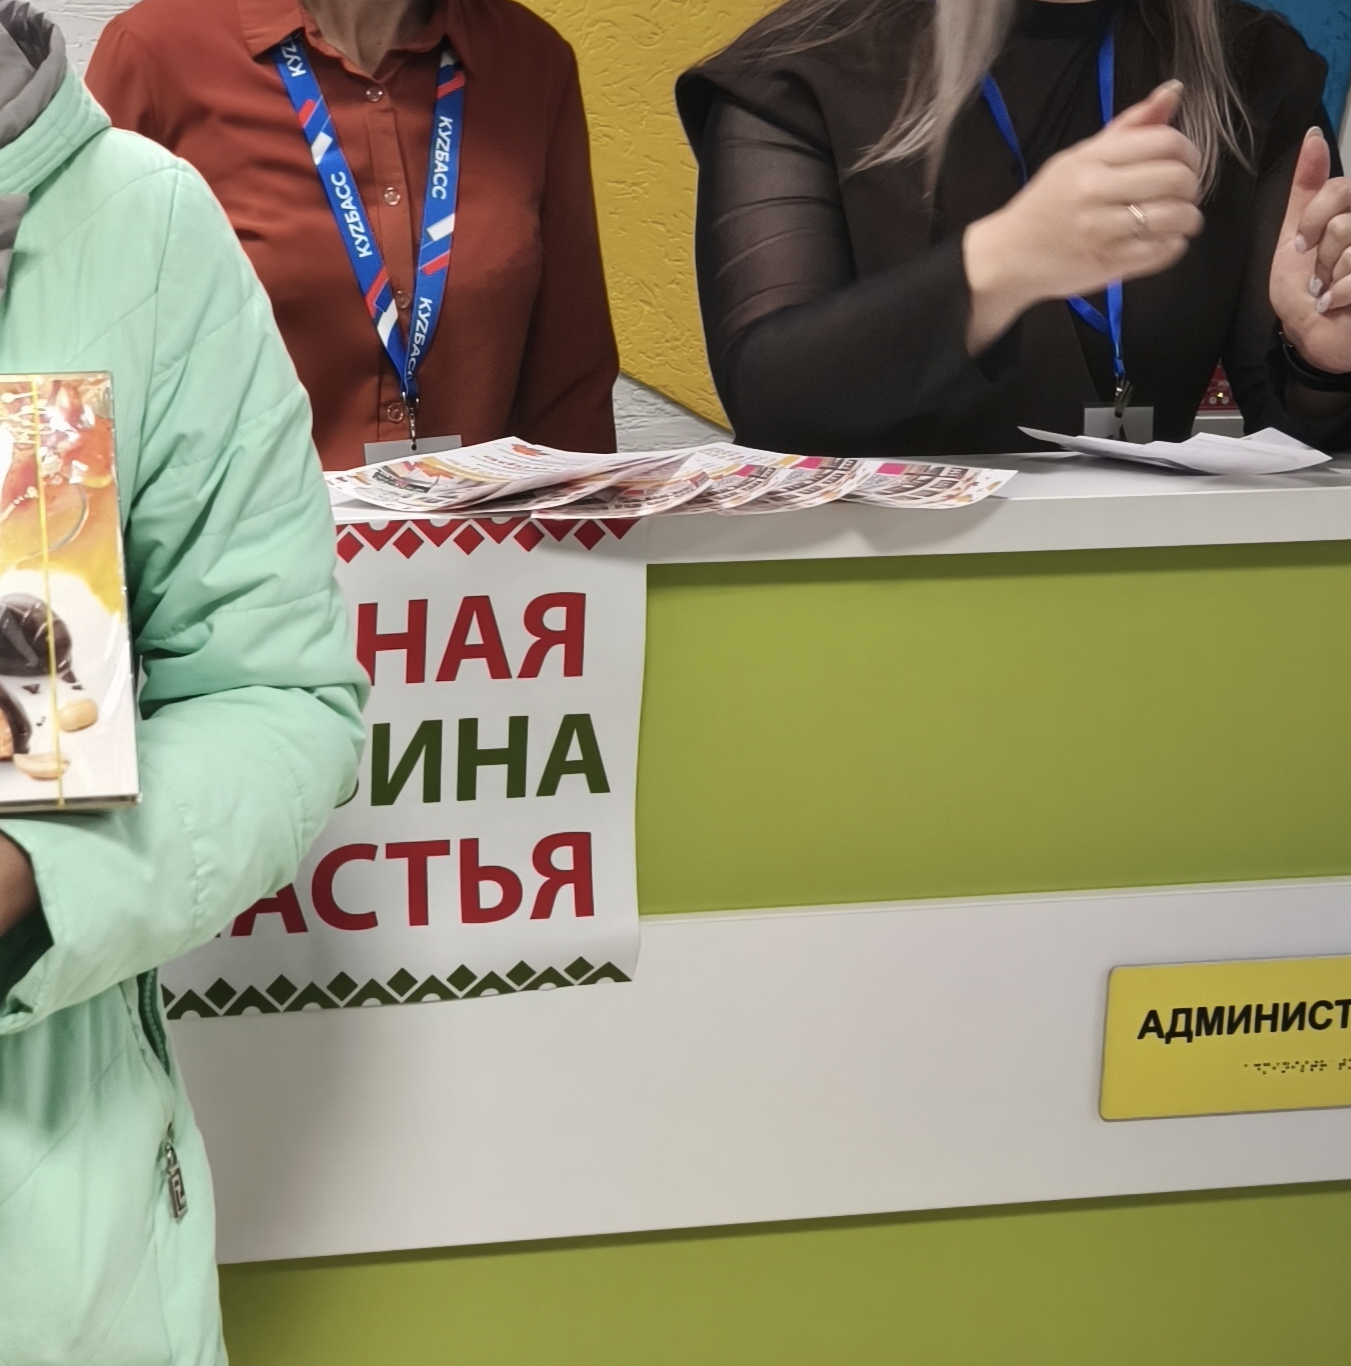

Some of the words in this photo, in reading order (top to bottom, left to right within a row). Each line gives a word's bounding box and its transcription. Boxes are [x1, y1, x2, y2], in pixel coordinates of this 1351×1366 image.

[335, 713, 611, 808] ИНА
[215, 832, 595, 938] АСТЬЯ
[1137, 998, 1351, 1045] АДМИНИСТ
